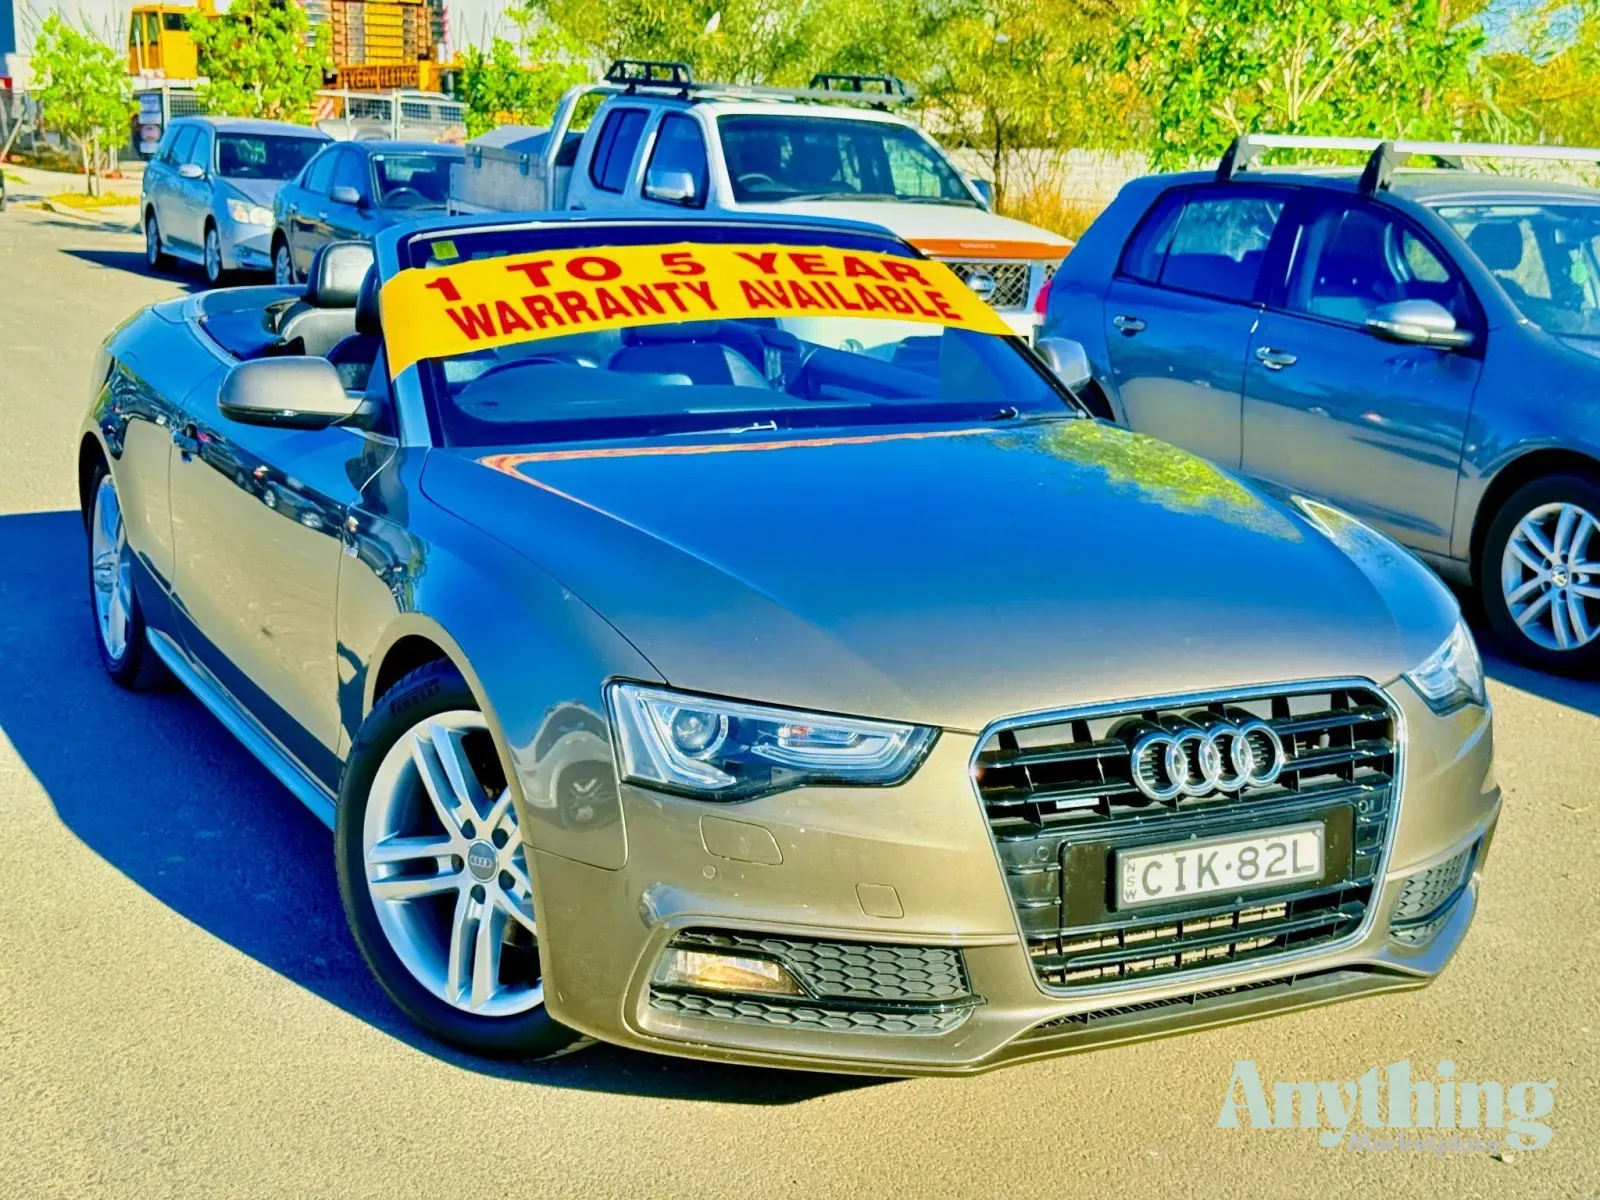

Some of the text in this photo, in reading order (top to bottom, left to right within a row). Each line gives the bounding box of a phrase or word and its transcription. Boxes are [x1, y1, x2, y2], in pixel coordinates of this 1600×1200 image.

[425, 252, 932, 302] 1 TO 5 YEAR
[445, 279, 962, 341] WARRANTY AVAILABLE
